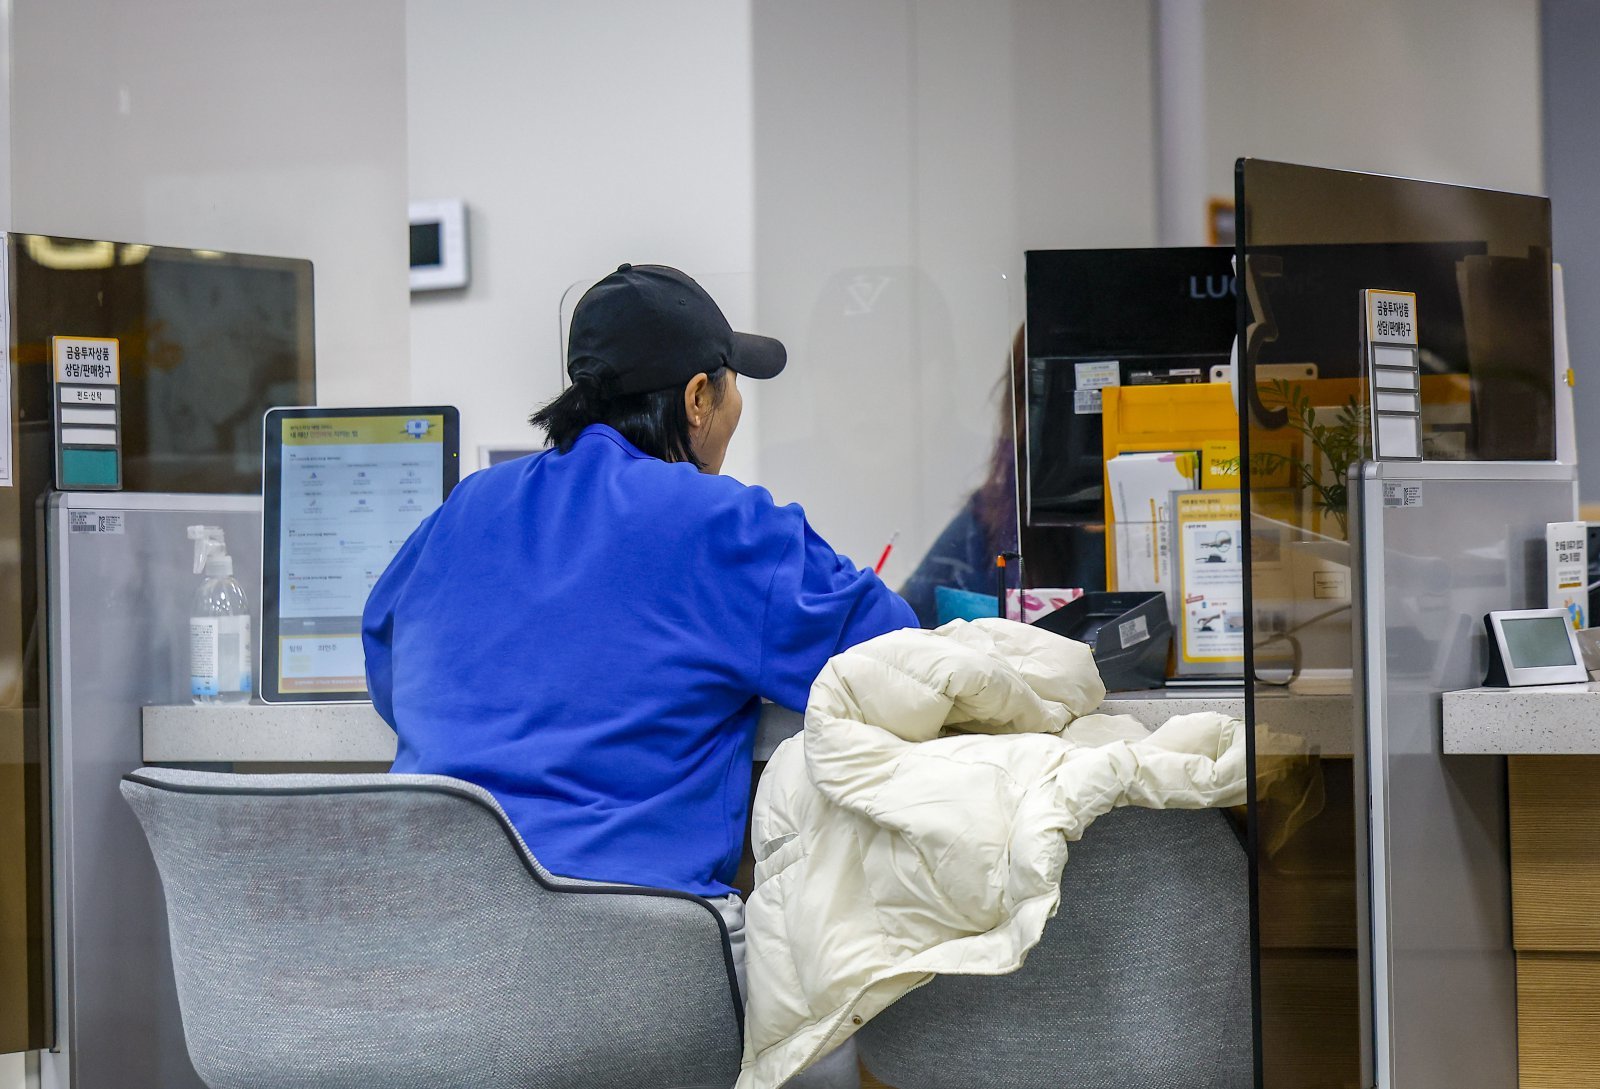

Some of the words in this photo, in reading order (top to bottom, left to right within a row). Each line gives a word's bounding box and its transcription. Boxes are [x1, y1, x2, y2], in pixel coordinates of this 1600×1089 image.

[1377, 301, 1409, 318] 금융투자상품
[1376, 320, 1411, 337] 상담/판매창구
[66, 346, 110, 361] 금융투자상품
[65, 363, 112, 378] 상담/판매창구
